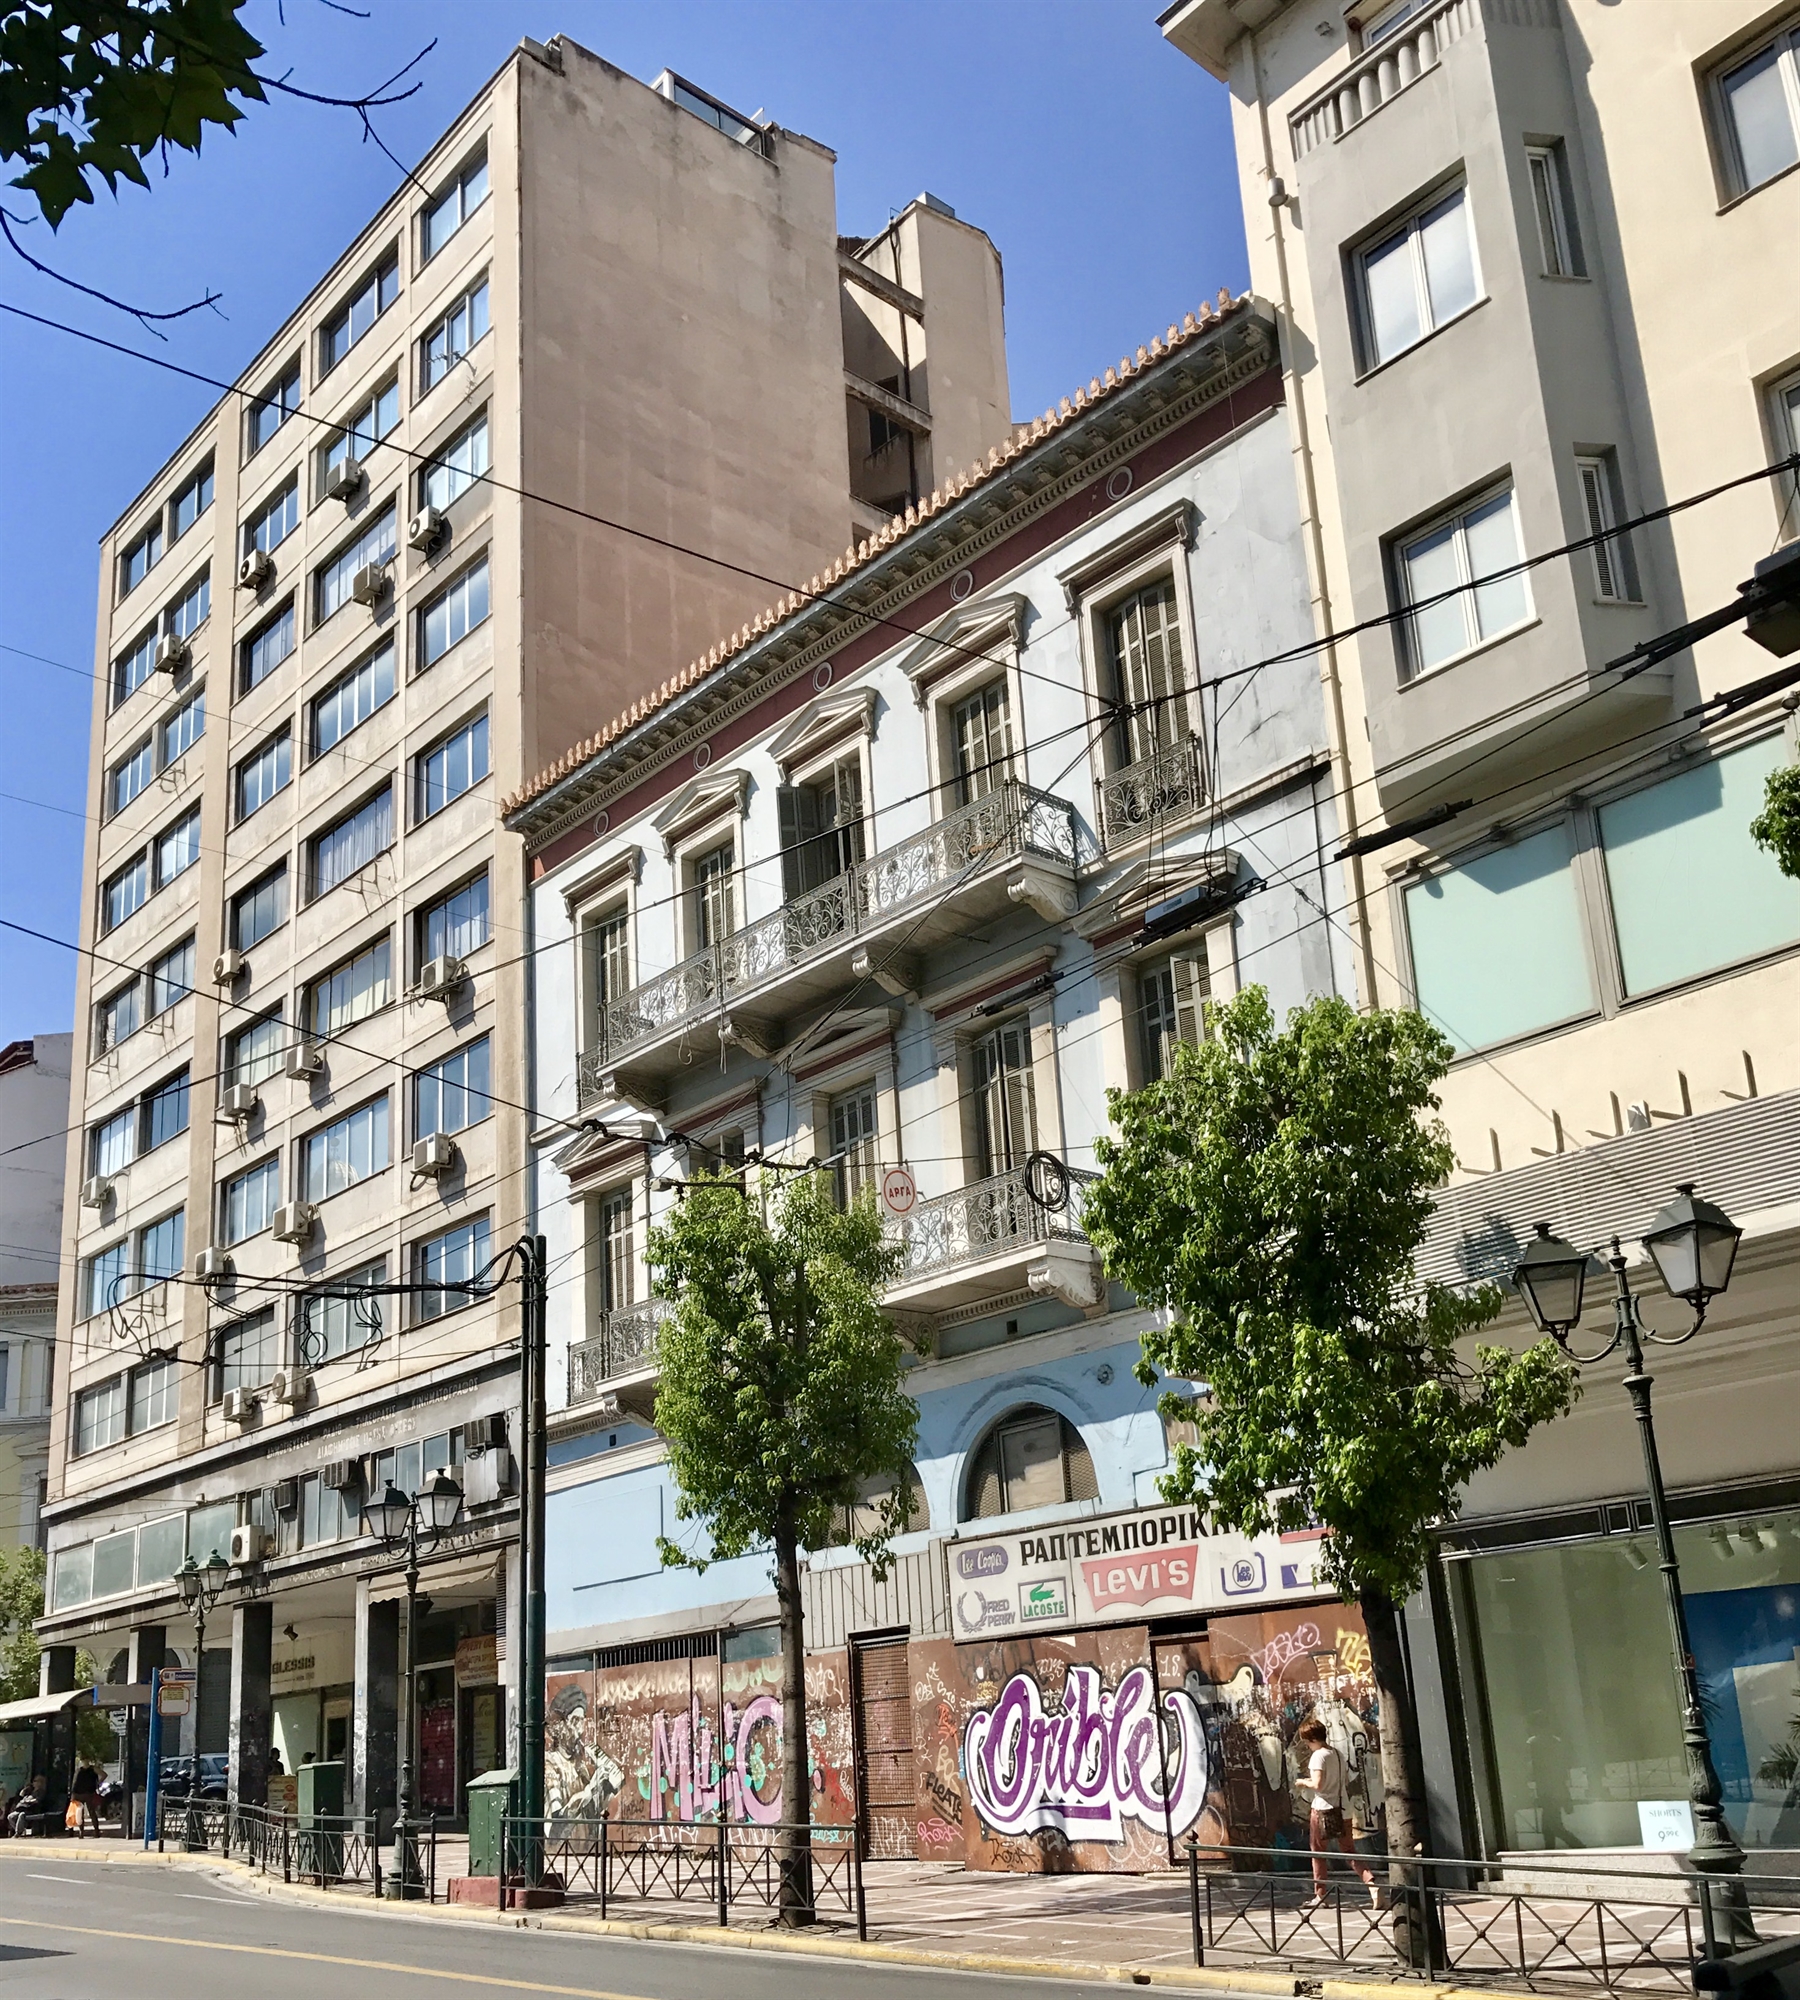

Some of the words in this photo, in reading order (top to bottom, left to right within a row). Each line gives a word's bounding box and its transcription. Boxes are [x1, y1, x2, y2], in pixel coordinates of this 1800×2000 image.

[1019, 1508, 1239, 1567] ΡΑΠΤΕΜΠΟΡΙΚ
[987, 1599, 1010, 1614] FRED
[1023, 1601, 1065, 1618] LACOSTE
[987, 1612, 1016, 1628] PERRY
[1649, 1808, 1682, 1818] SHORTS
